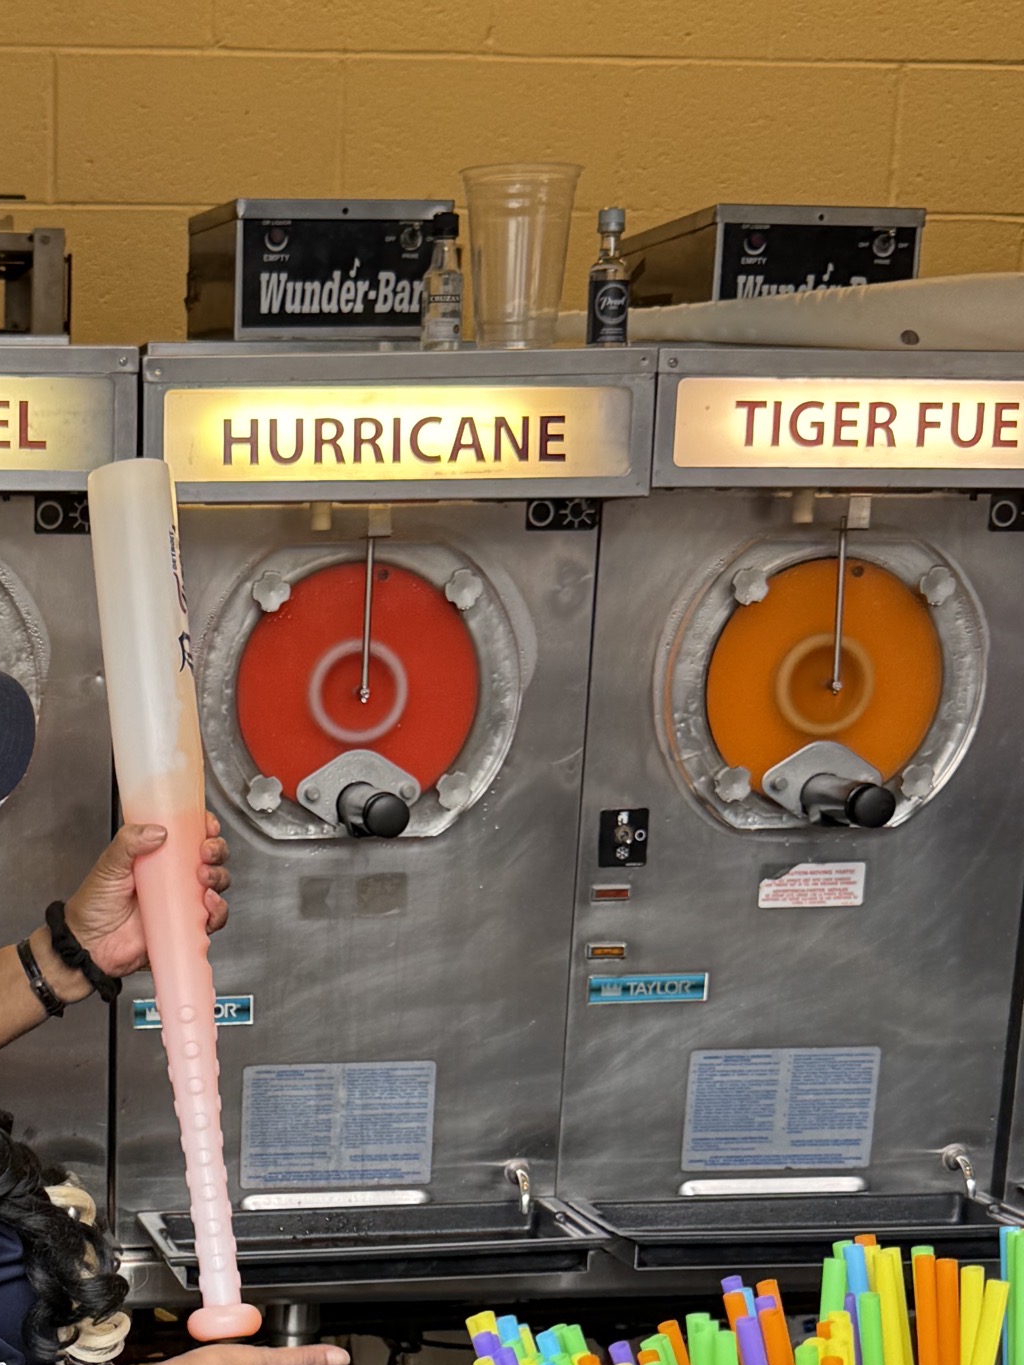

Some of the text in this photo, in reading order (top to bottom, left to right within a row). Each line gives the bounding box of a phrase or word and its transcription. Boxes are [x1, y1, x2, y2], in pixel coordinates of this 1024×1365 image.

[259, 270, 427, 314] Wunder-Bar
[223, 415, 566, 465] HURRICANE
[735, 400, 1021, 449] TIGER FUE
[626, 980, 693, 996] TAYLOR
